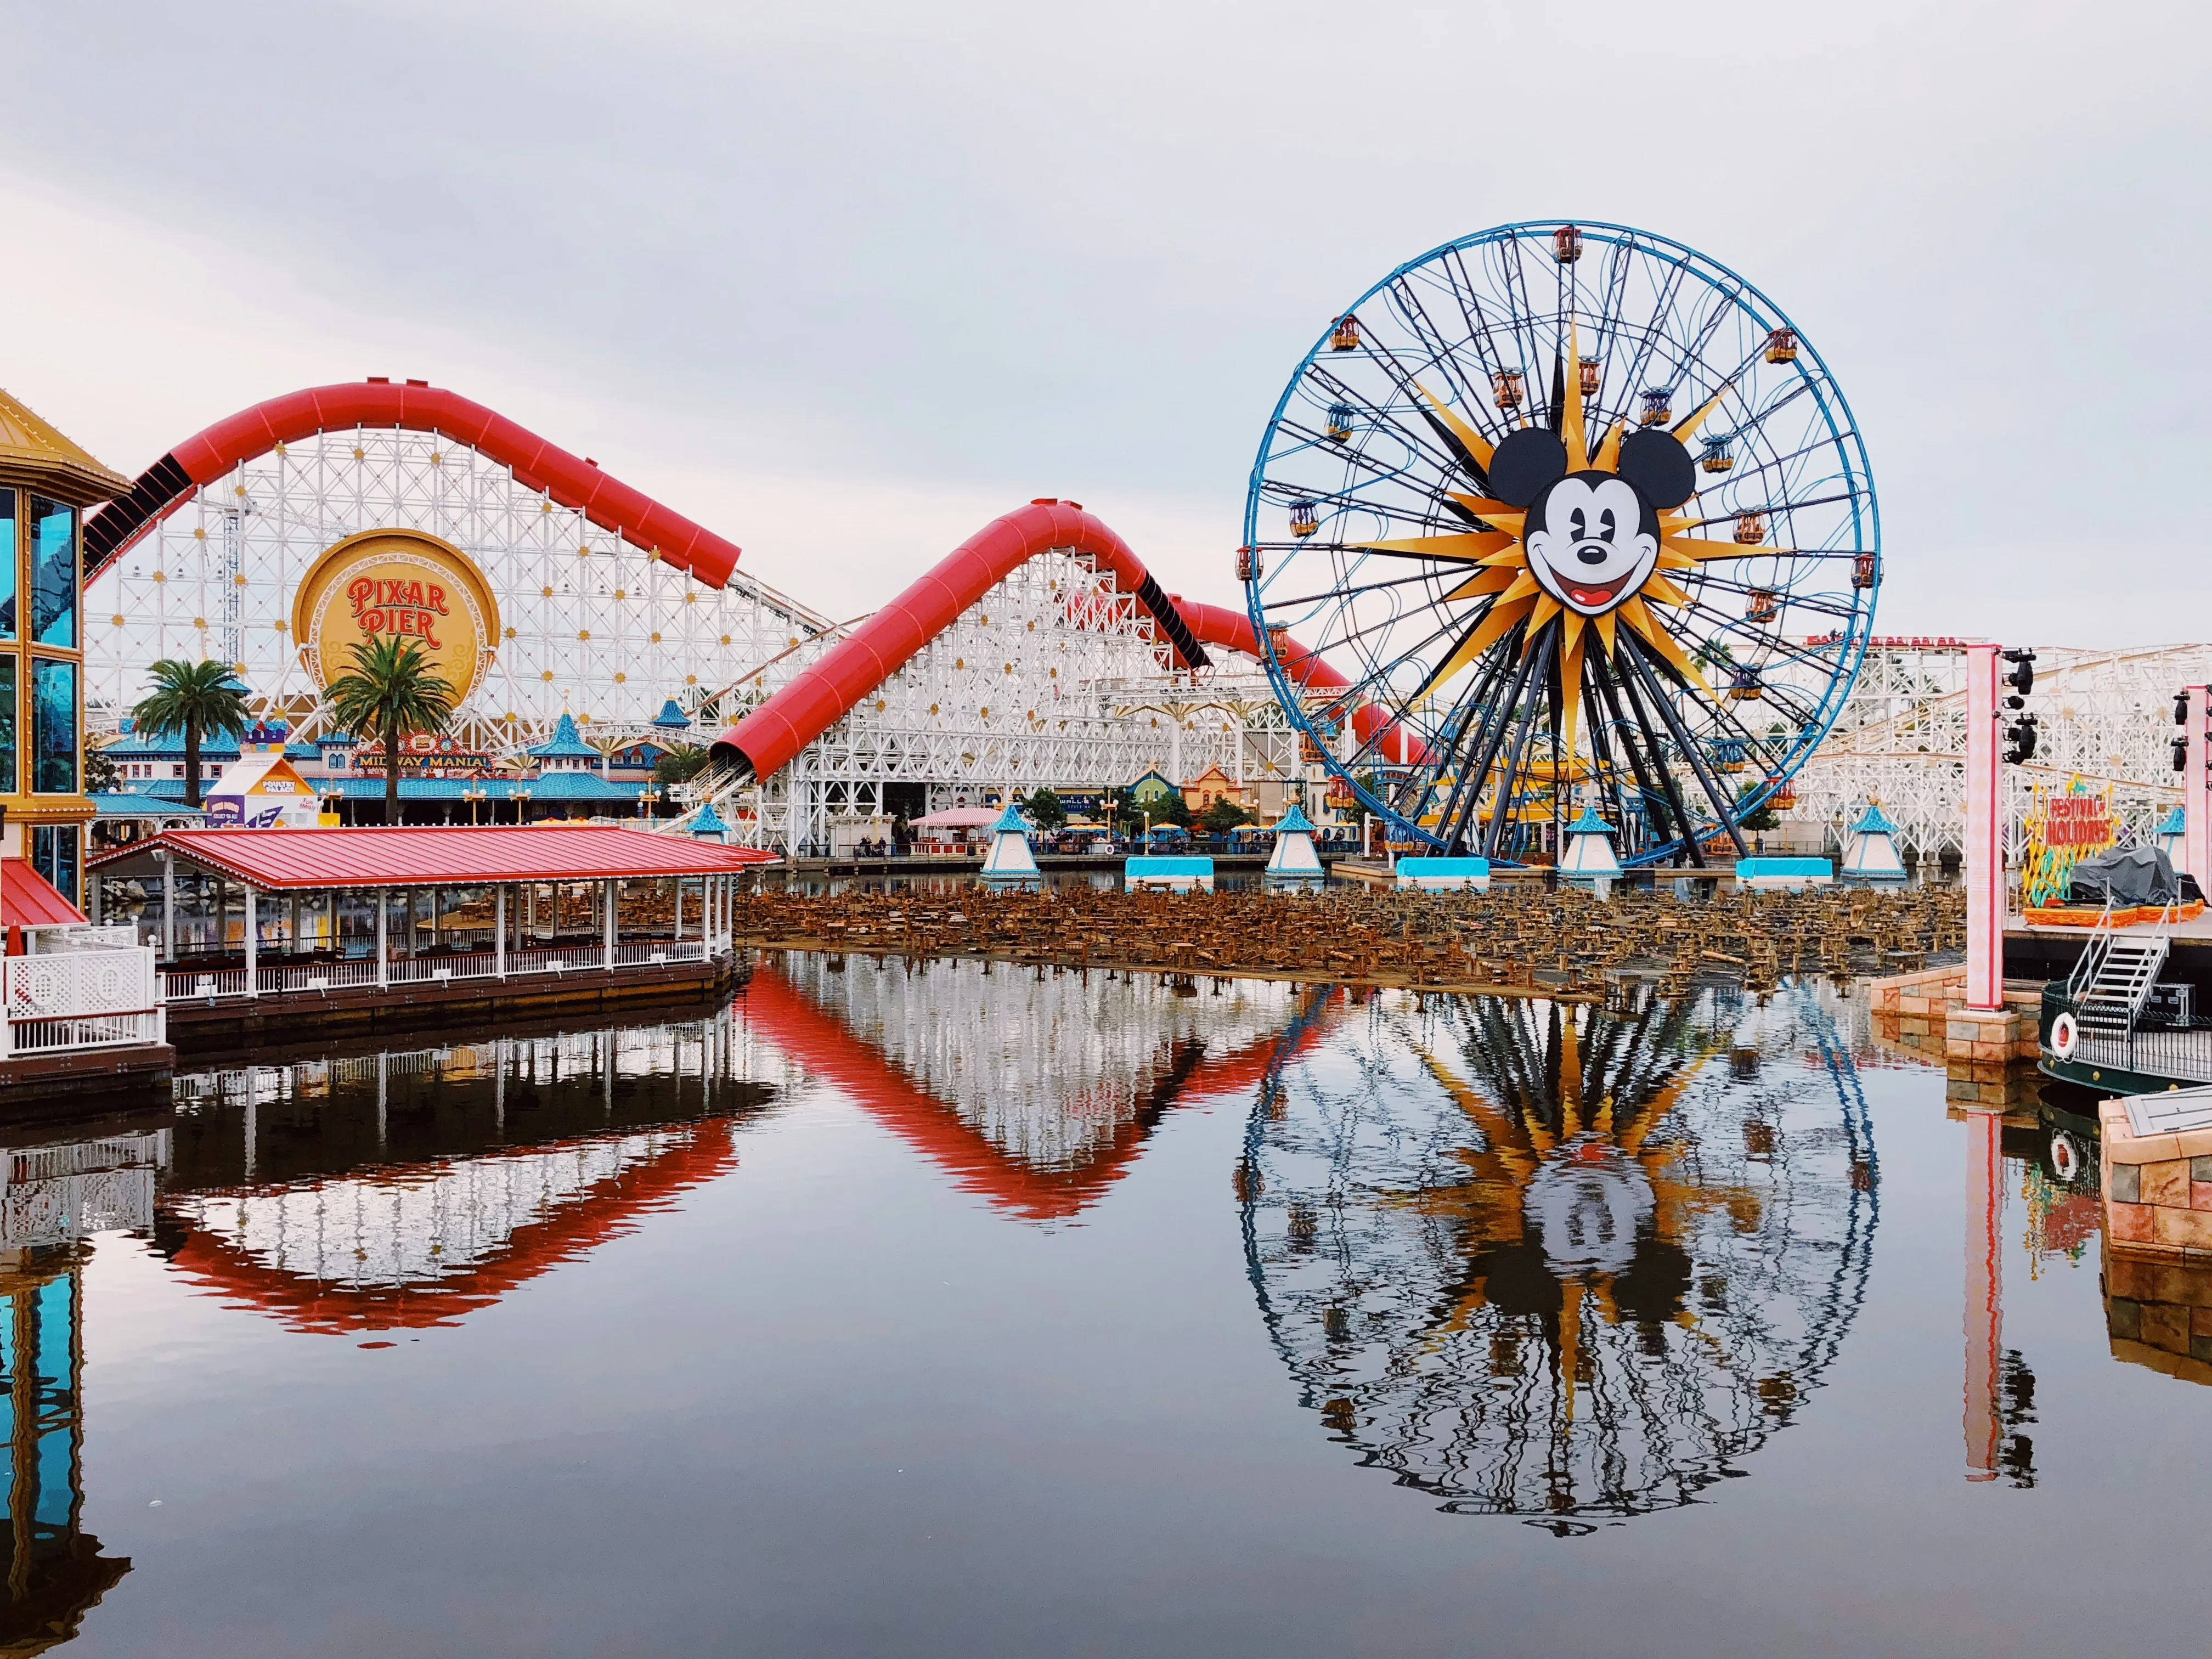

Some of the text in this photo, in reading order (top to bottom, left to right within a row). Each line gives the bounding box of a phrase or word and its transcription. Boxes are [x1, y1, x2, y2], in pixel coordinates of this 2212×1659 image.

[347, 576, 450, 618] PIXAR
[358, 607, 442, 650] PIER
[429, 757, 487, 767] MANIA!
[2050, 798, 2098, 817] FESTIVAL
[2047, 819, 2110, 845] HOLIDAYS
